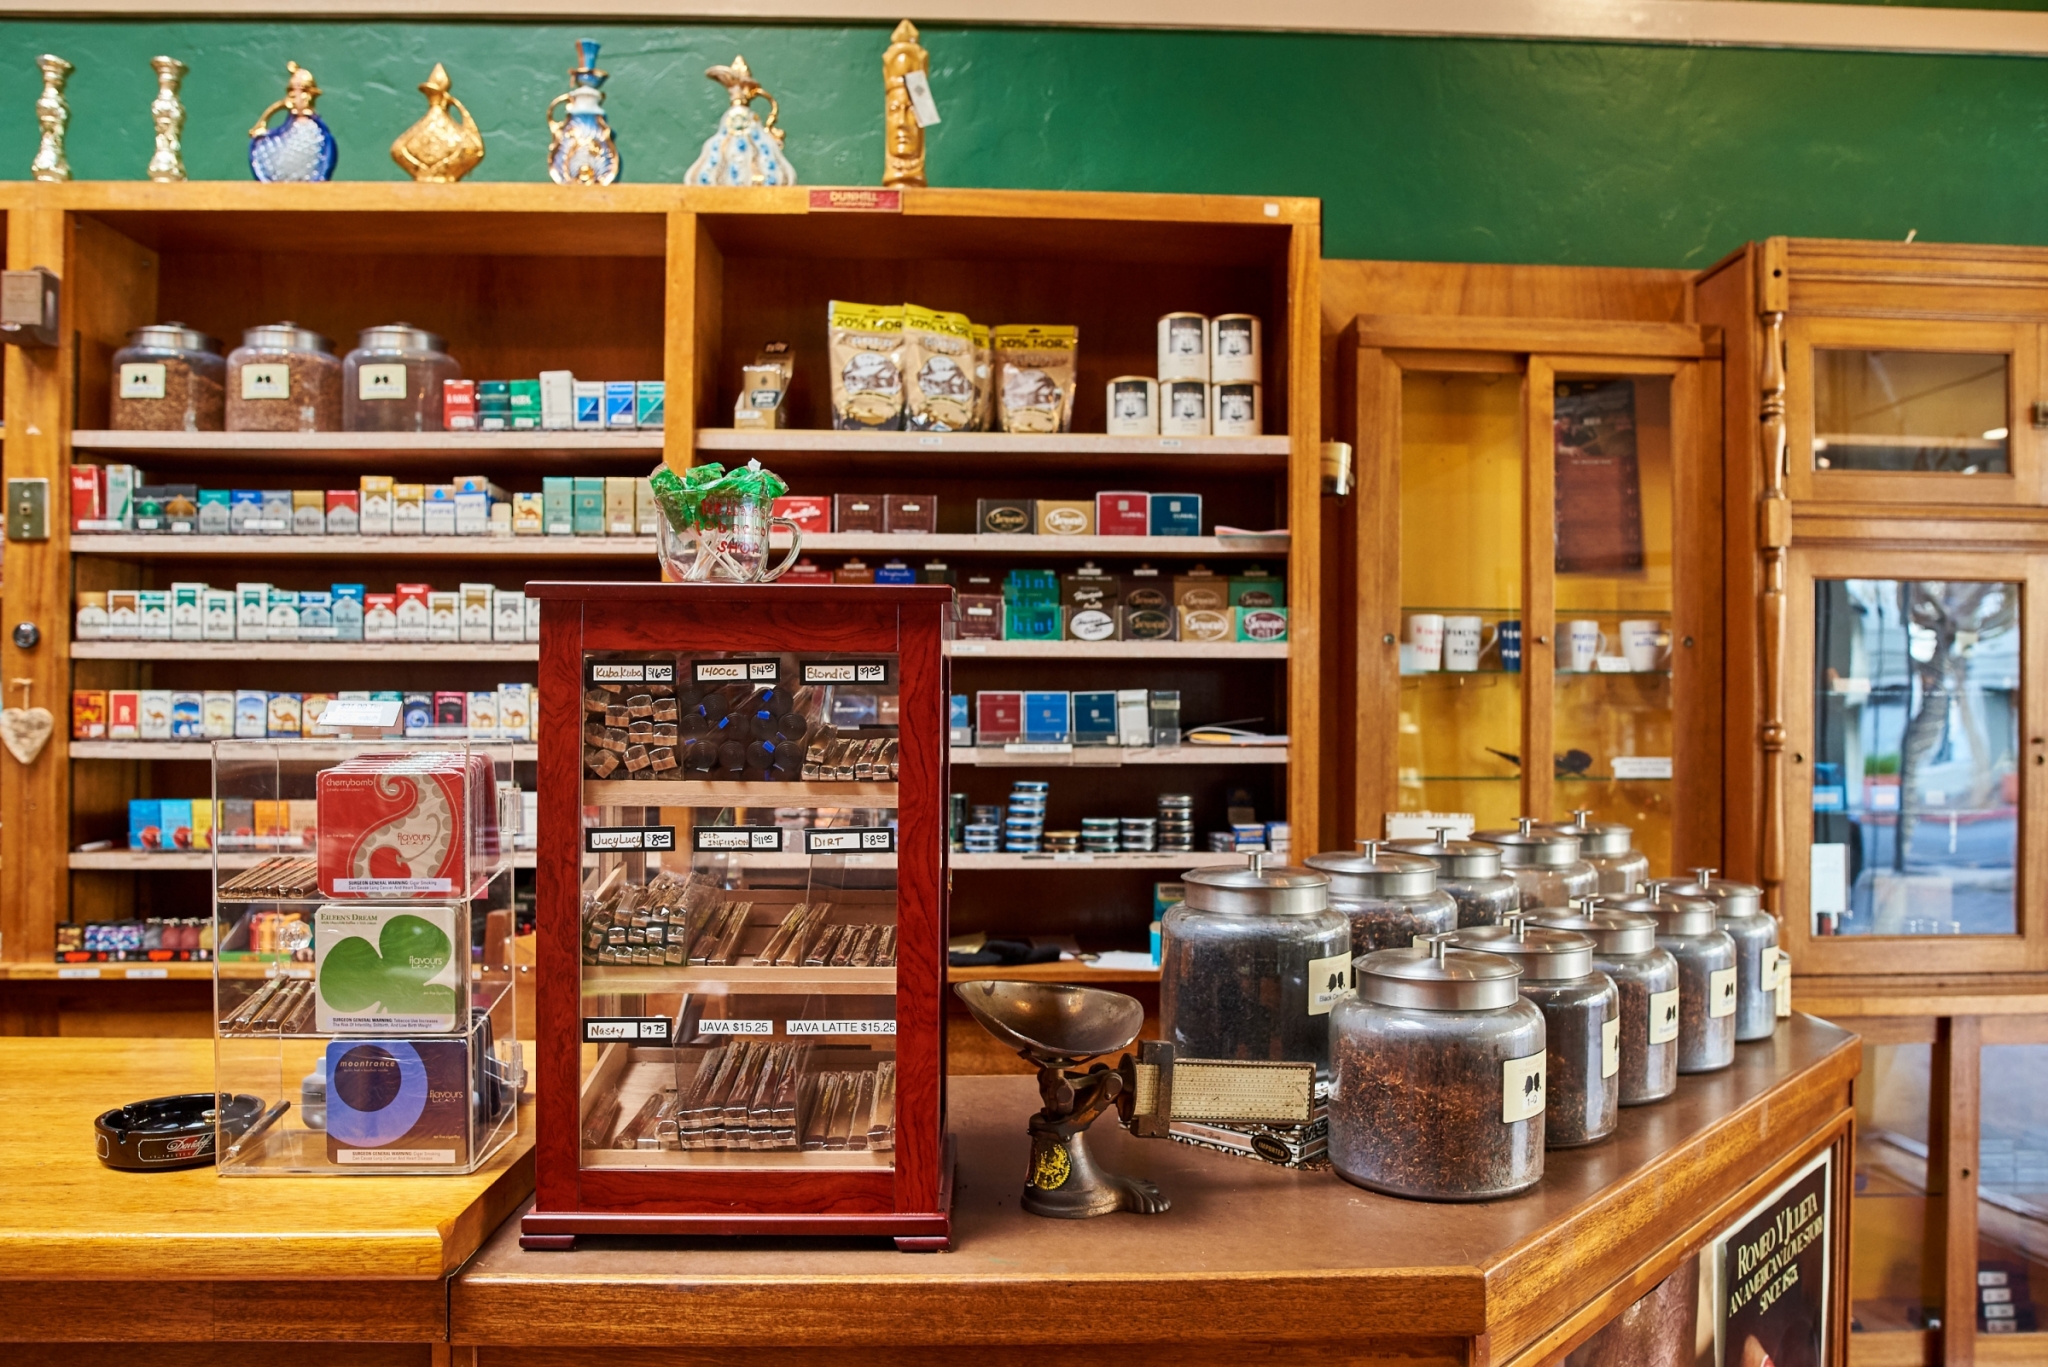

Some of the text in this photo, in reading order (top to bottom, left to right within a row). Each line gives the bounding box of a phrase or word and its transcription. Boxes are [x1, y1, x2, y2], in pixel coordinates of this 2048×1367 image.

[871, 318, 902, 331] MOR
[1011, 570, 1055, 590] hint
[1012, 613, 1053, 633] hint
[807, 667, 852, 679] Blondie
[326, 778, 374, 789] cherrybomb
[397, 832, 431, 843] flavours
[814, 836, 844, 848] DIRT
[351, 913, 378, 921] DREAM
[409, 955, 443, 967] flavours
[591, 1025, 625, 1038] Nasty
[699, 1021, 769, 1033] JAVA $15.25
[789, 1021, 896, 1033] JAVA LATTE $15.25
[340, 1060, 396, 1068] moontrance
[429, 1090, 463, 1101] flavours
[1257, 1141, 1285, 1157] IMPORTED
[1738, 1226, 1776, 1280] ROMEO
[1784, 1191, 1818, 1246] JULIETA
[1743, 1251, 1785, 1305] AMERICAN
[1782, 1231, 1804, 1266] LOVE
[1760, 1277, 1782, 1316] SINCE
